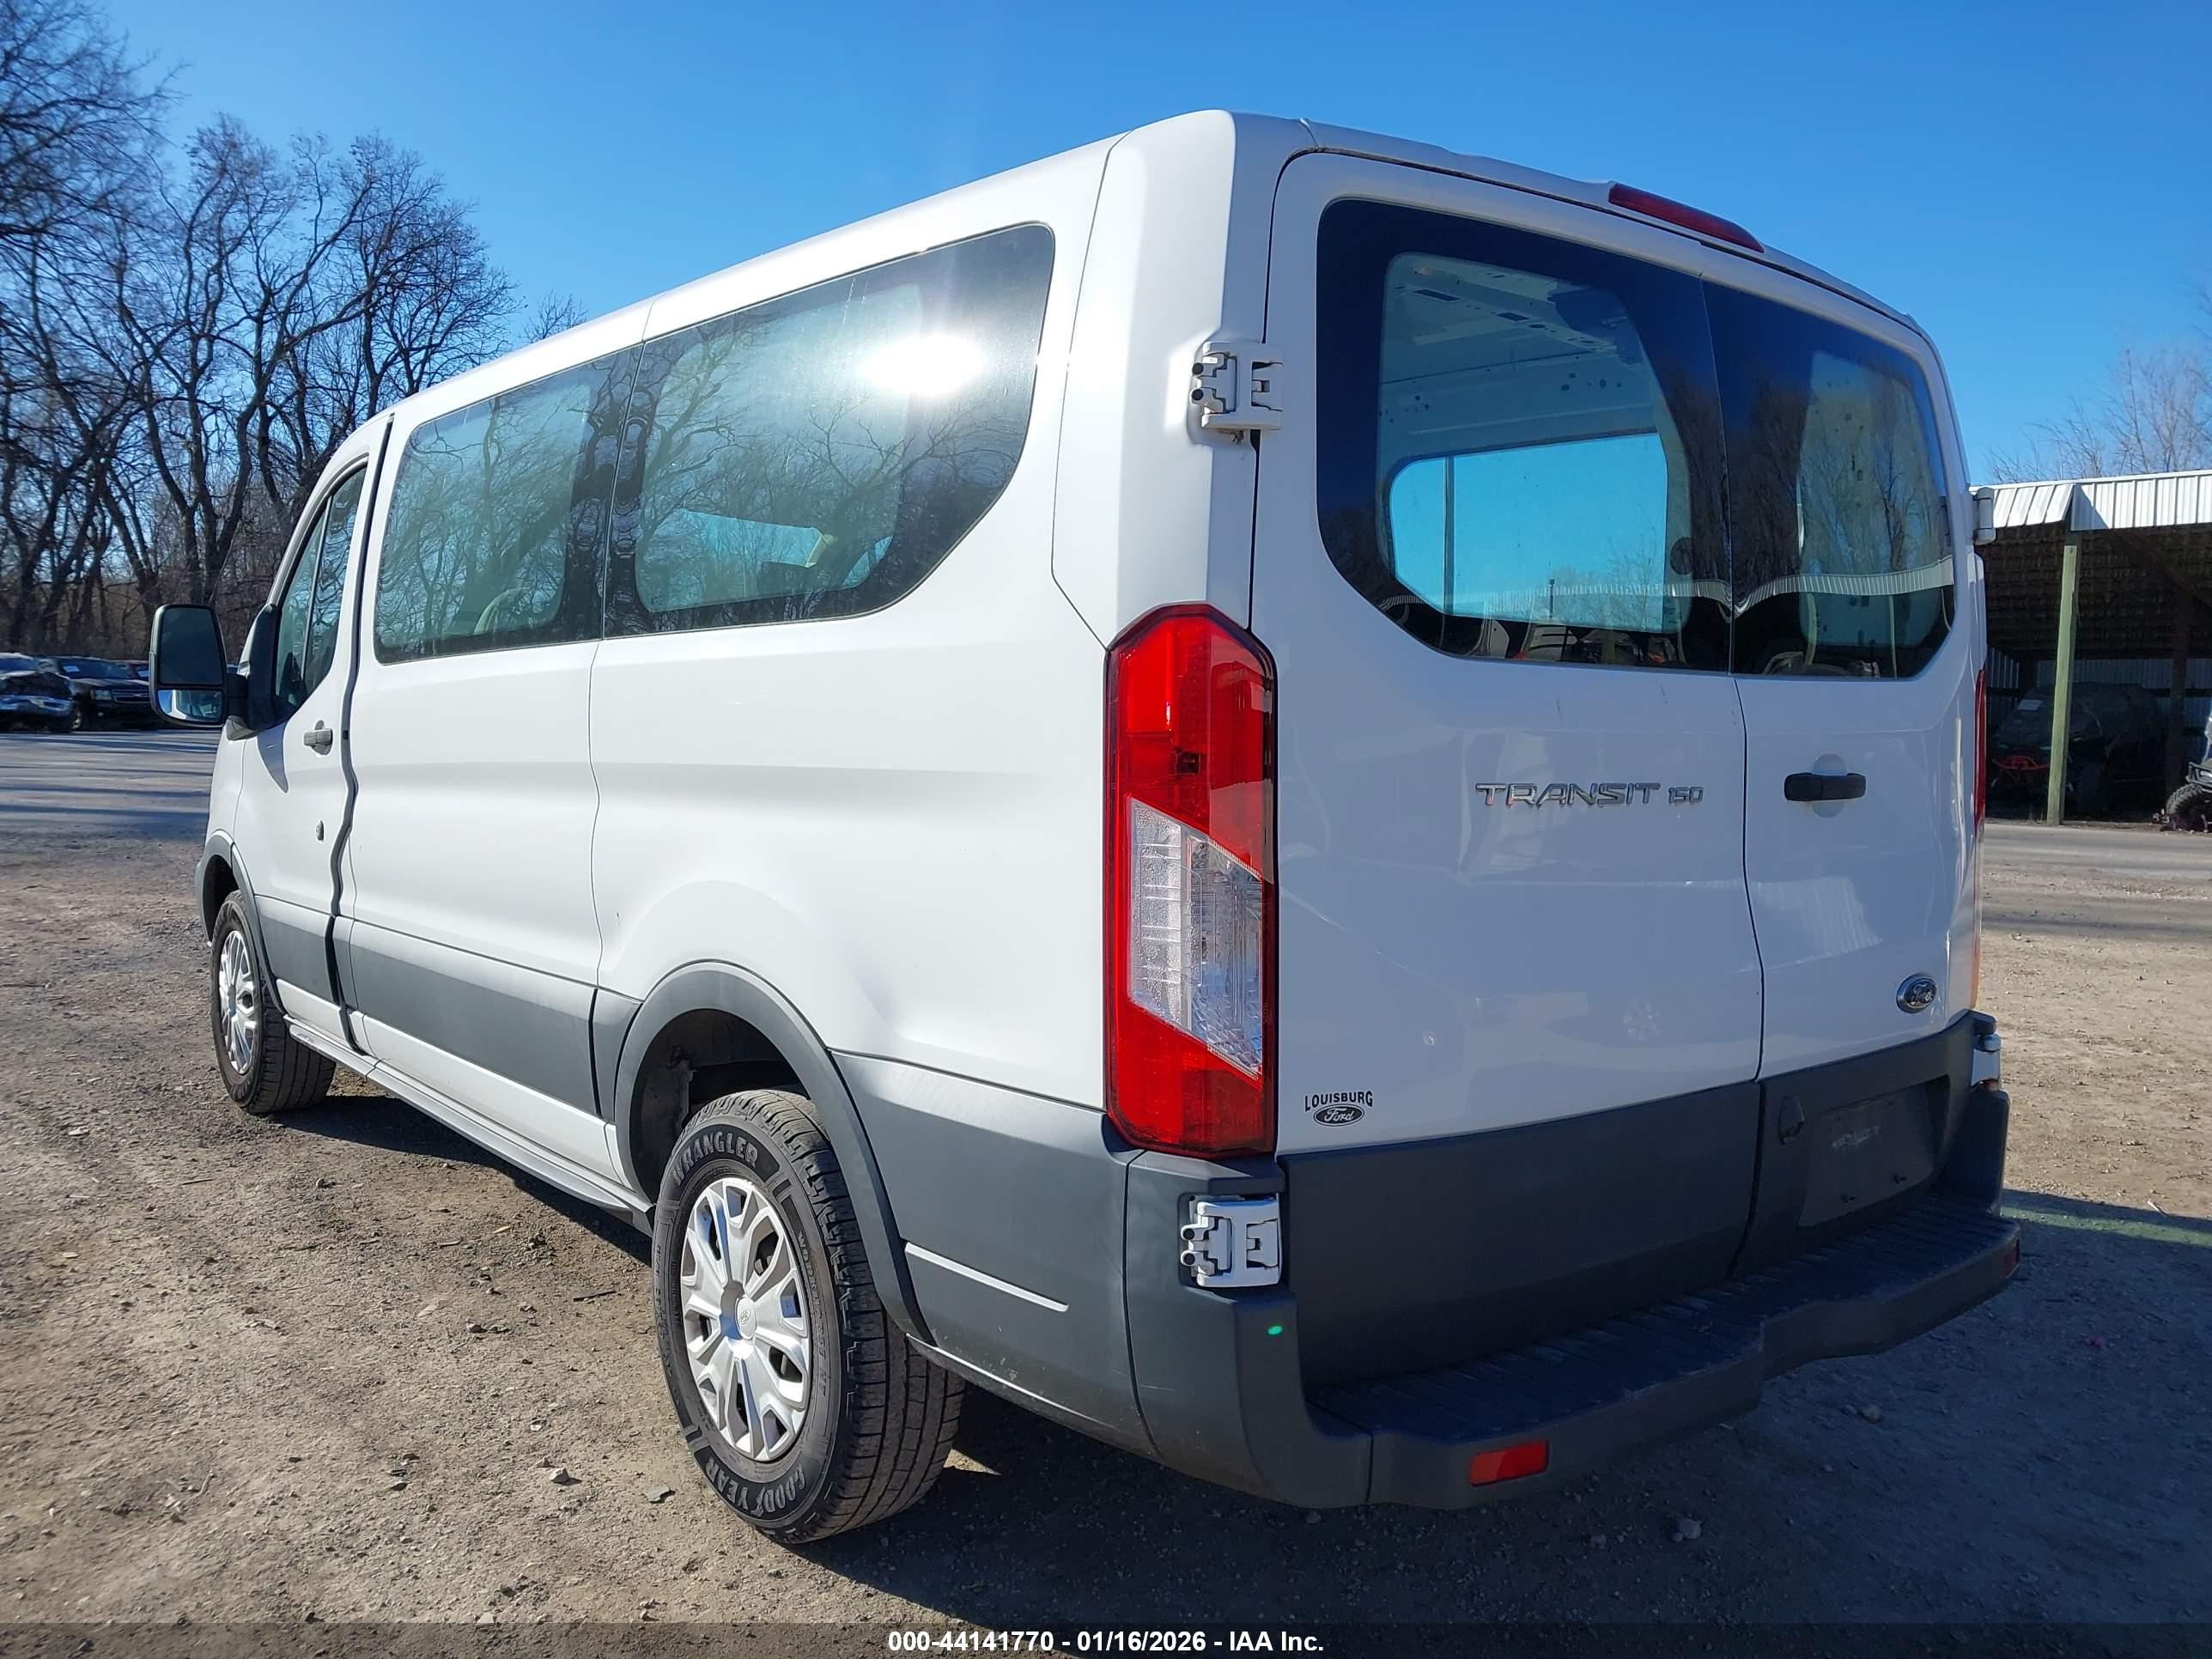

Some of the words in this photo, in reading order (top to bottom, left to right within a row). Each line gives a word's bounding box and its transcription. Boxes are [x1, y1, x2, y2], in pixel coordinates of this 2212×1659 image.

[1475, 782, 1661, 808] TRANSIT
[1668, 786, 1705, 805] 150
[1304, 1091, 1374, 1112] LOUISBURG
[1323, 1107, 1355, 1122] Ford
[672, 1131, 758, 1186] WRANGLER
